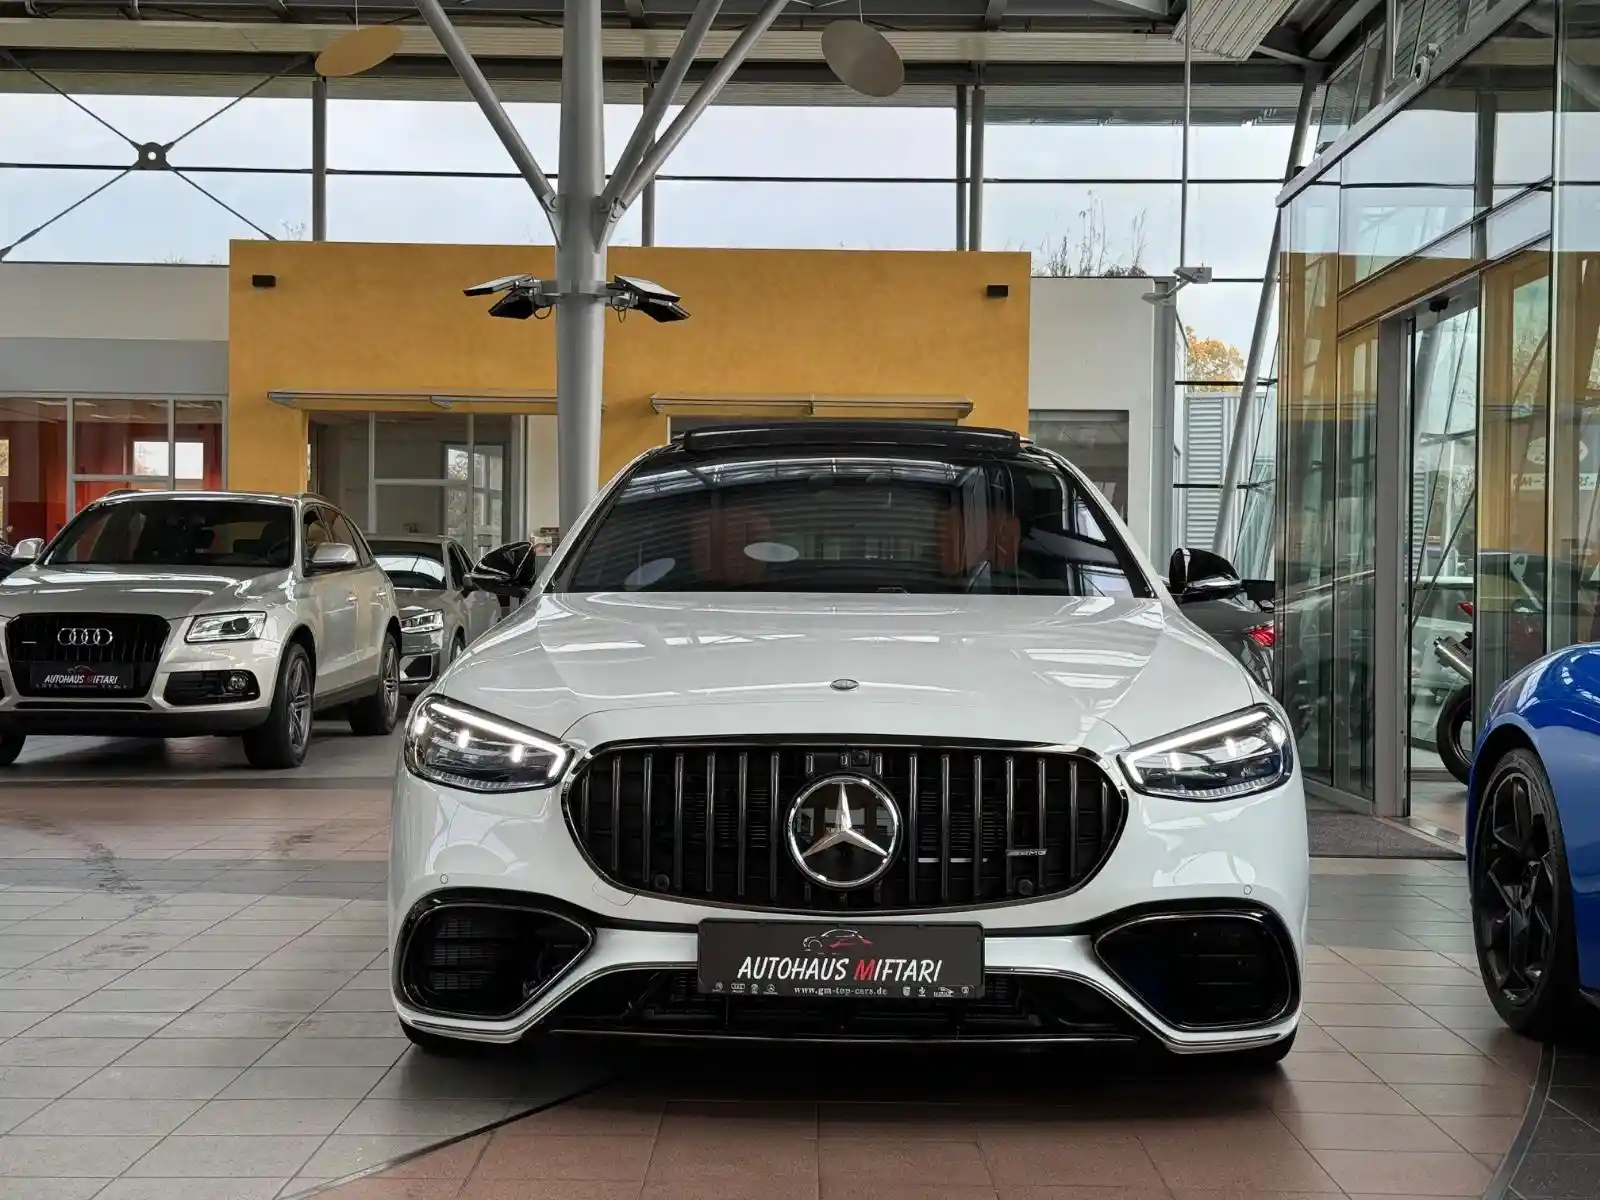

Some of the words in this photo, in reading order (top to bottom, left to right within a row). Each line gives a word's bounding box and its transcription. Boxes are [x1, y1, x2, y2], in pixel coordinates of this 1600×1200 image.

[44, 674, 85, 684] AUTOHAUS
[737, 956, 849, 981] AUTOHAUS
[853, 958, 943, 983] MIFTARI
[794, 986, 888, 997] www.gm-top-cars.de
